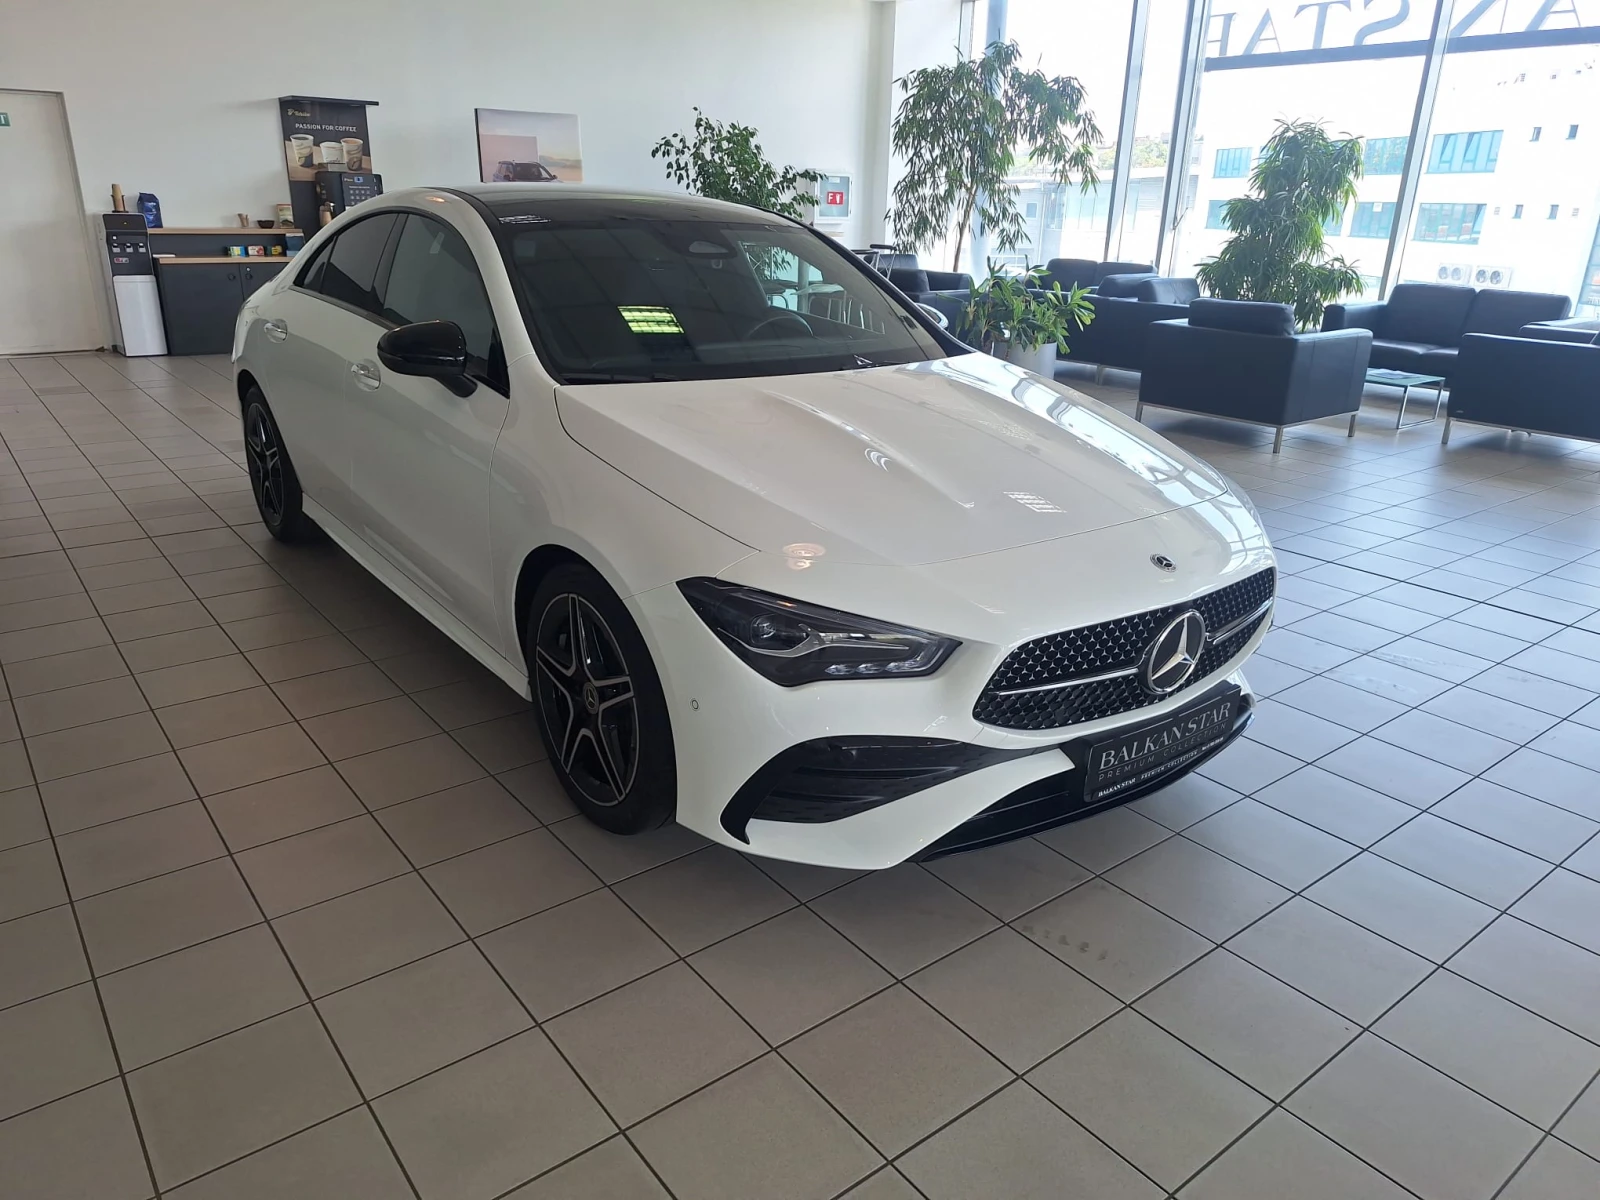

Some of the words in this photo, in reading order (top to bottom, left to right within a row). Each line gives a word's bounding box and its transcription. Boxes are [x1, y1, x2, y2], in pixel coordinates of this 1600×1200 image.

[335, 125, 357, 133] COFFEE
[828, 193, 834, 203] F
[1099, 723, 1184, 770] BALKAN
[1186, 702, 1231, 736] STAR
[1099, 754, 1155, 782] PREMIUM
[1163, 722, 1226, 757] COLLECTION
